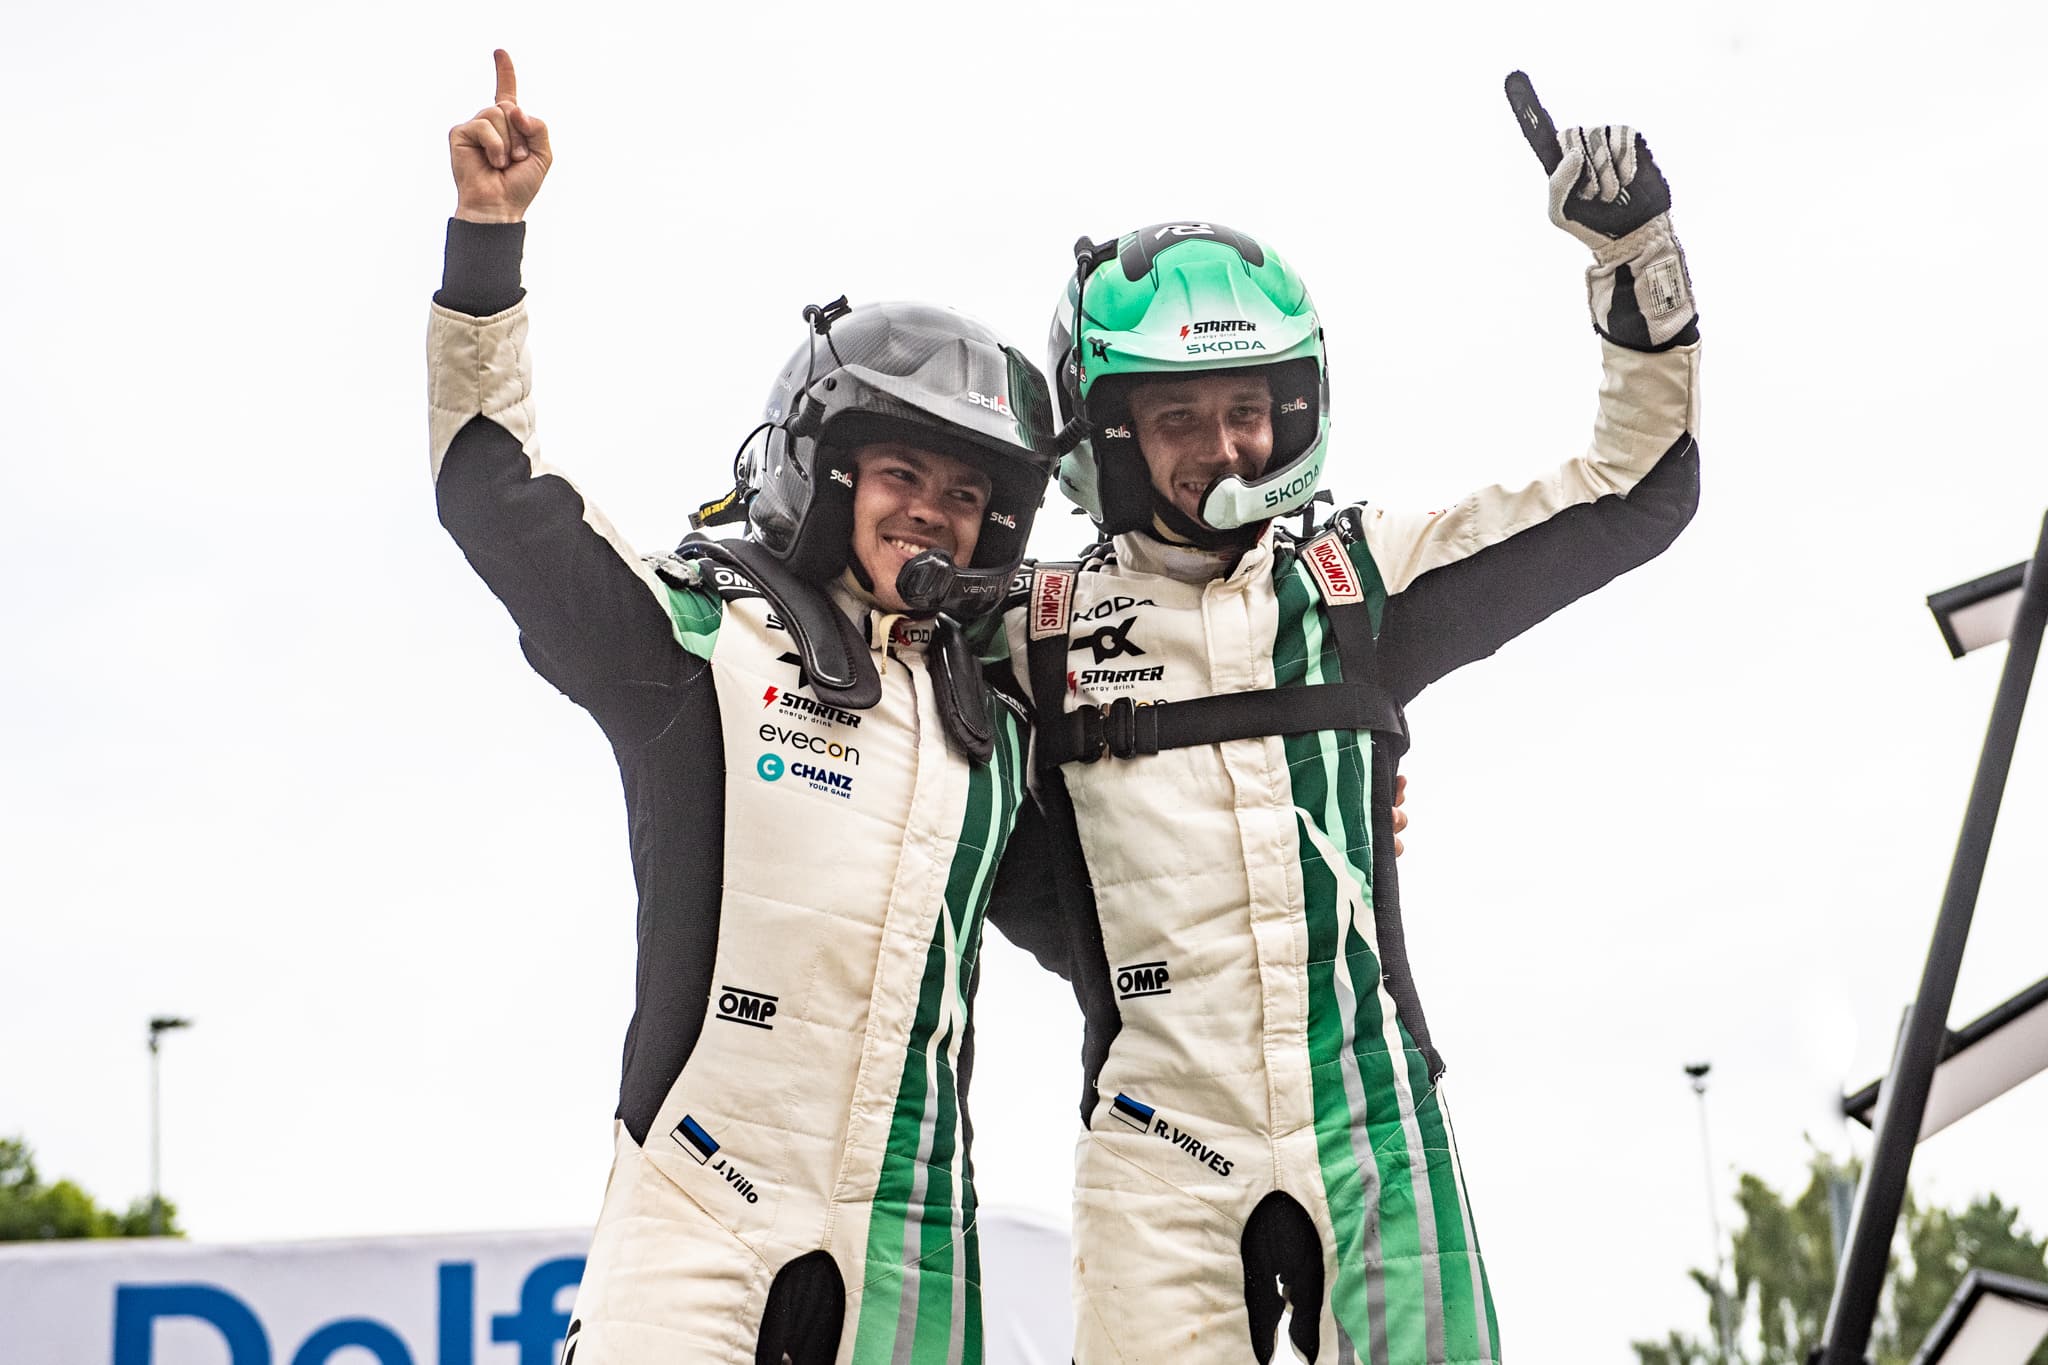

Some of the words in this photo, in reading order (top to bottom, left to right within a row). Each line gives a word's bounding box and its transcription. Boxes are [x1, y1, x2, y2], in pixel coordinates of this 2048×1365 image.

[1193, 320, 1256, 334] STARTER
[968, 391, 1010, 417] Stilo
[1281, 399, 1307, 414] Stilo
[1105, 426, 1131, 439] Stilo
[830, 469, 853, 488] Stilo
[1265, 464, 1320, 509] SKODA
[990, 511, 1017, 530] Stilo
[715, 571, 753, 588] OM
[1313, 542, 1351, 593] SIMPSON
[1041, 575, 1063, 627] SIMPSON
[1073, 597, 1159, 622] KODA
[1080, 666, 1164, 685] STARTER
[1113, 683, 1135, 691] drink
[779, 709, 807, 721] energy
[811, 717, 832, 728] drink
[781, 692, 861, 728] STARTER
[759, 724, 859, 765] evecon
[791, 762, 853, 791] CHANZ
[808, 782, 828, 793] YOUR
[831, 788, 850, 799] GAME
[1117, 967, 1169, 993] OMP
[719, 993, 776, 1022] OMP
[1154, 1120, 1234, 1176] R.VIRVES
[712, 1160, 758, 1204] J.Viilo
